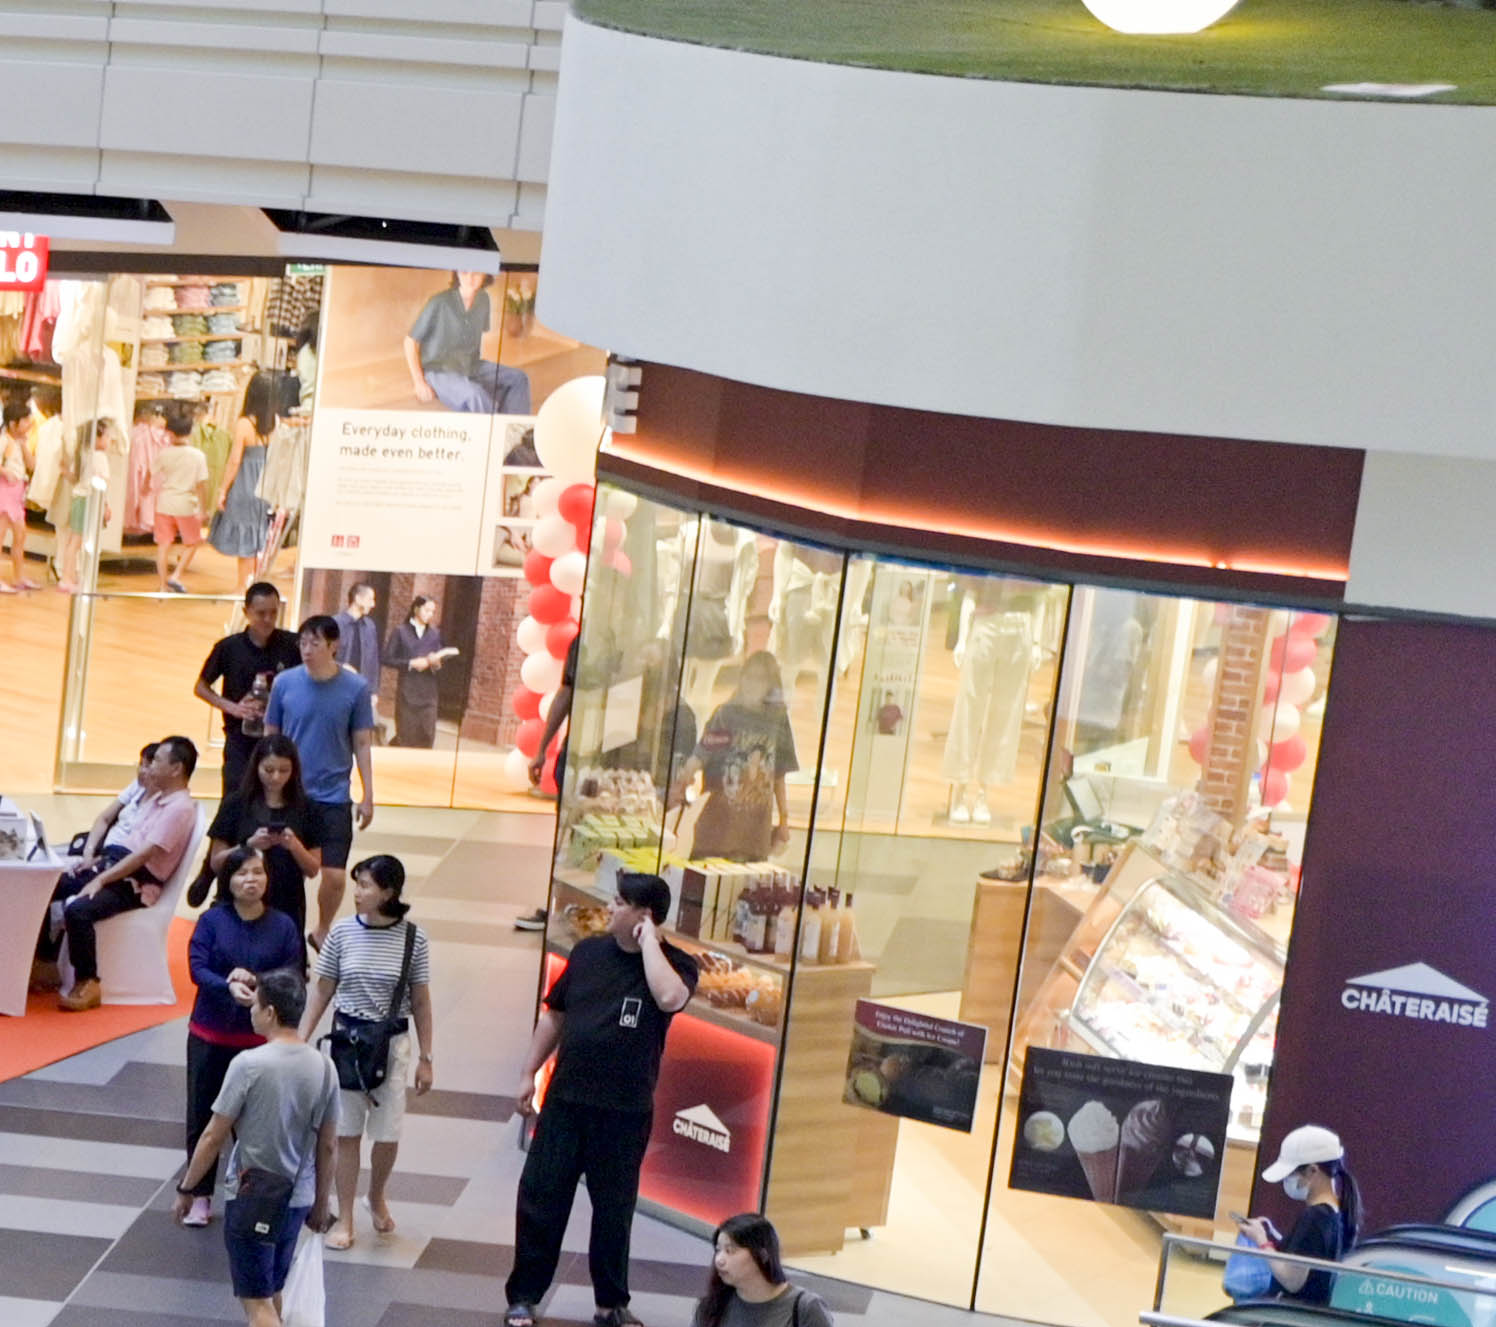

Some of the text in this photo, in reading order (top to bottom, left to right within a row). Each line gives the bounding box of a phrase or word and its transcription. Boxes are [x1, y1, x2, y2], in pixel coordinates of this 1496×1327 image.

[342, 422, 406, 439] Everyday
[339, 445, 377, 457] made
[382, 448, 413, 458] even
[1376, 1286, 1438, 1304] CAUTION
